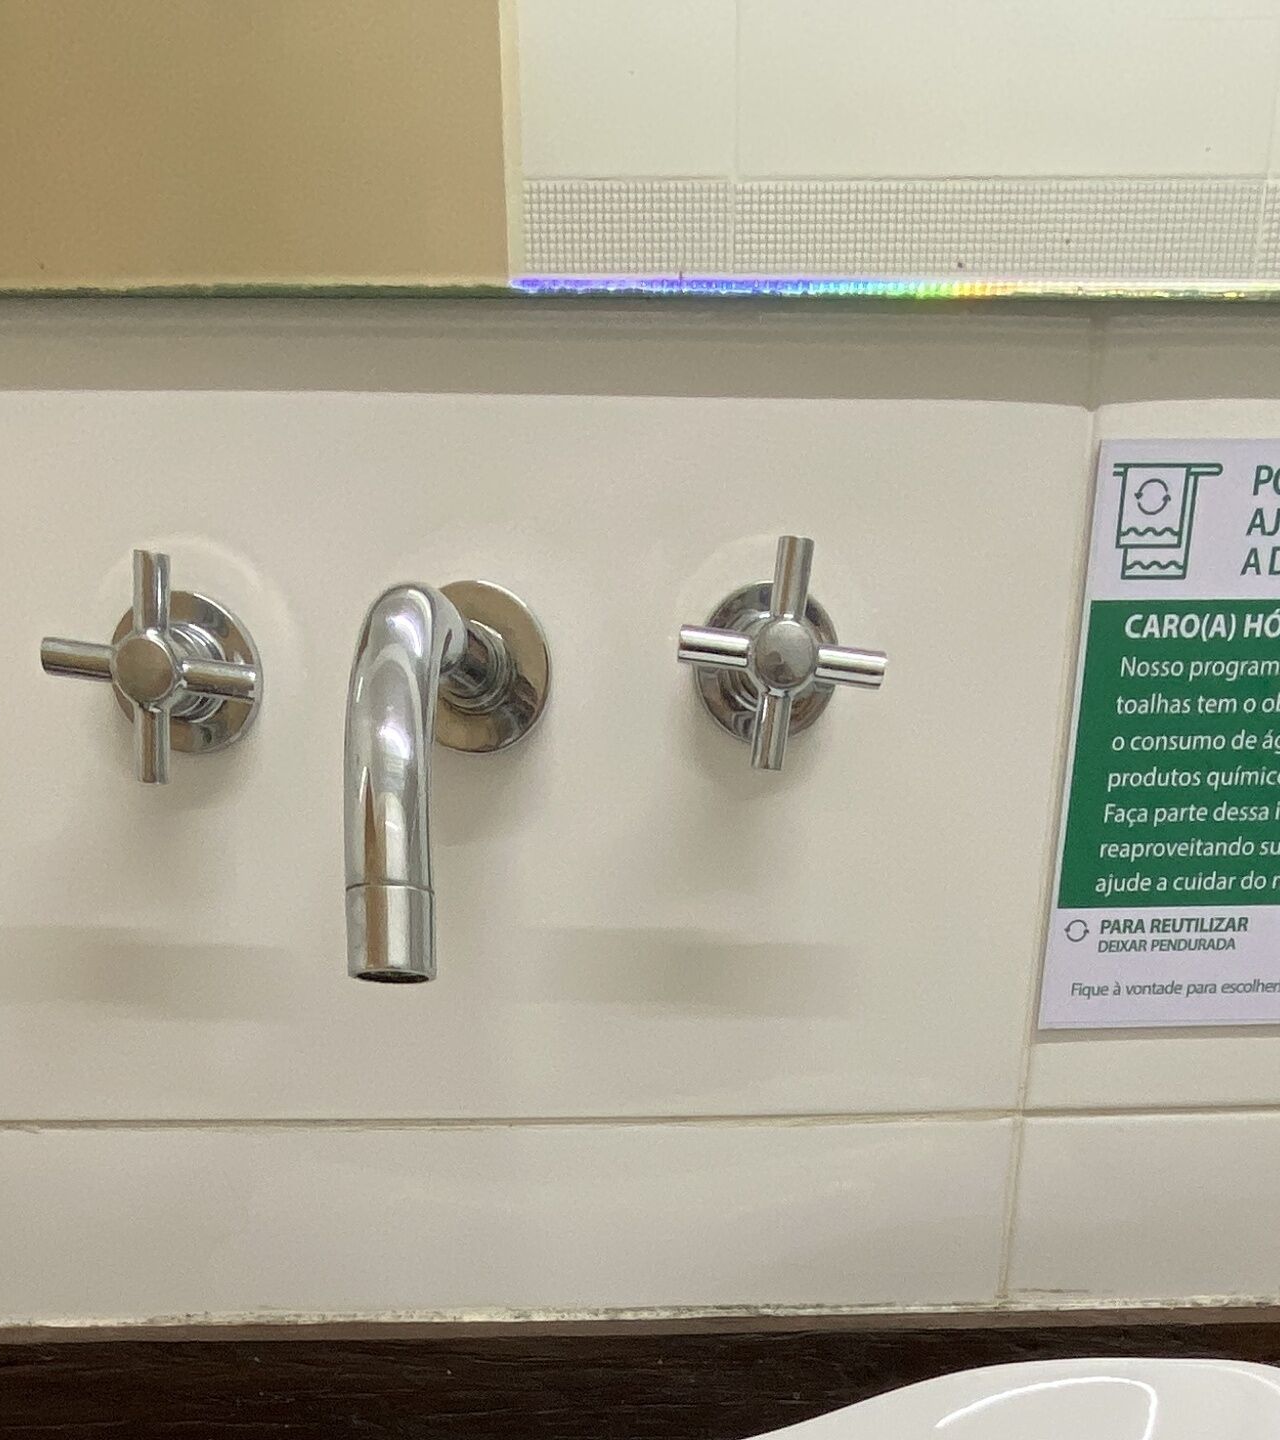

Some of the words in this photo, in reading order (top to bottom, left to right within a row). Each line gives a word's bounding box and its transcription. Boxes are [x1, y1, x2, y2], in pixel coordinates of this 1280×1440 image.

[1239, 546, 1262, 576] A
[1124, 613, 1236, 642] CARO(A)
[1120, 656, 1184, 677] Nosso
[1116, 693, 1191, 715] toalhas
[1197, 695, 1237, 714] tem
[1243, 698, 1257, 713] o
[1111, 735, 1125, 751] o
[1130, 733, 1226, 751] consumo
[1231, 729, 1257, 750] de
[1107, 767, 1201, 792] produtos
[1103, 804, 1148, 829] Faça
[1153, 804, 1208, 828] parte
[1213, 801, 1270, 822] dessa
[1099, 837, 1254, 862] reaproveitando
[1095, 871, 1152, 897] ajude
[1156, 876, 1168, 892] a
[1173, 871, 1235, 892] cuidar
[1240, 870, 1267, 890] do
[1100, 918, 1145, 934] PARA
[1150, 917, 1249, 933] REUTILIZAR
[1097, 938, 1148, 953] DEIXAR
[1151, 936, 1236, 952] PENDURADA
[1071, 980, 1110, 1000] Fique
[1112, 980, 1121, 996] à
[1125, 980, 1182, 996] vontade
[1186, 981, 1217, 998] para
